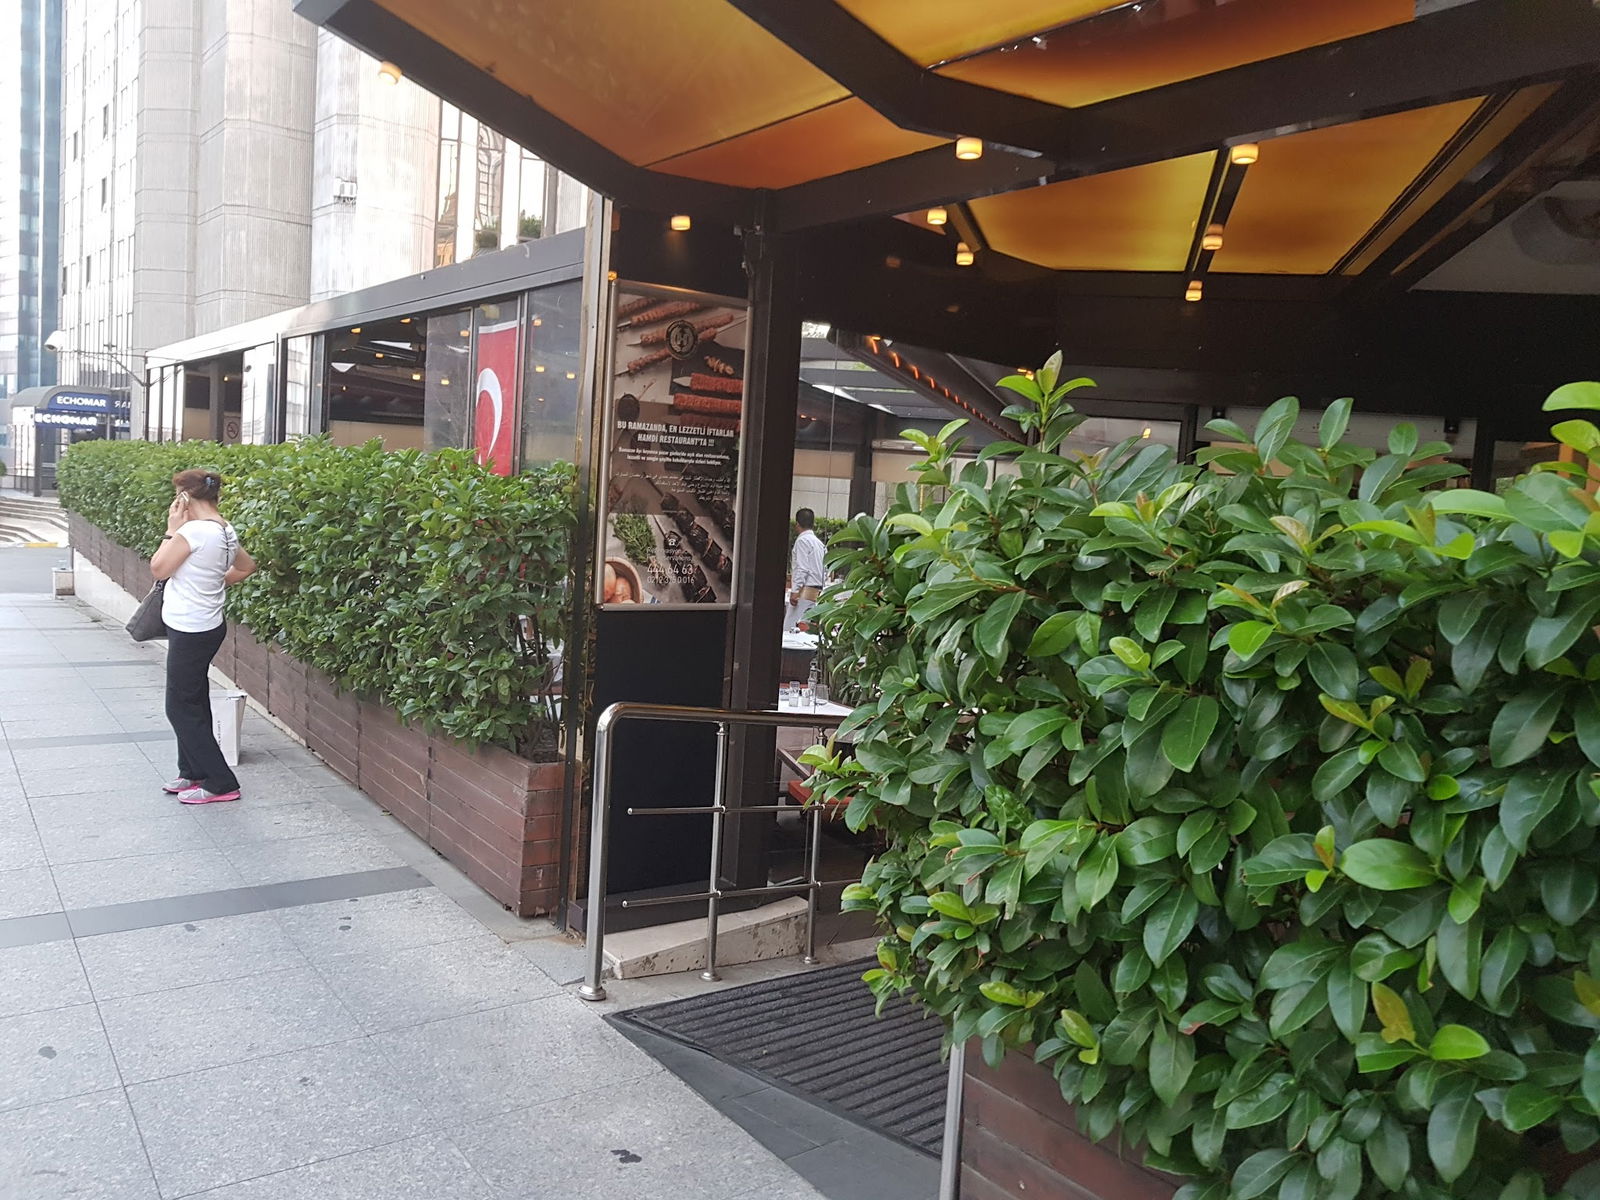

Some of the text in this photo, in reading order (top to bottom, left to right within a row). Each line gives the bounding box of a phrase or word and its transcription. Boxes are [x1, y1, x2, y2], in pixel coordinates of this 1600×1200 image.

[56, 396, 107, 408] ECHOMAR
[617, 420, 734, 437] BU RAMAZANDA, EN LEZZETLİ İFTARLAR
[637, 433, 658, 442] HAMDİ
[659, 435, 707, 447] RESTAURANT'TA
[648, 563, 694, 575] 444 64 63
